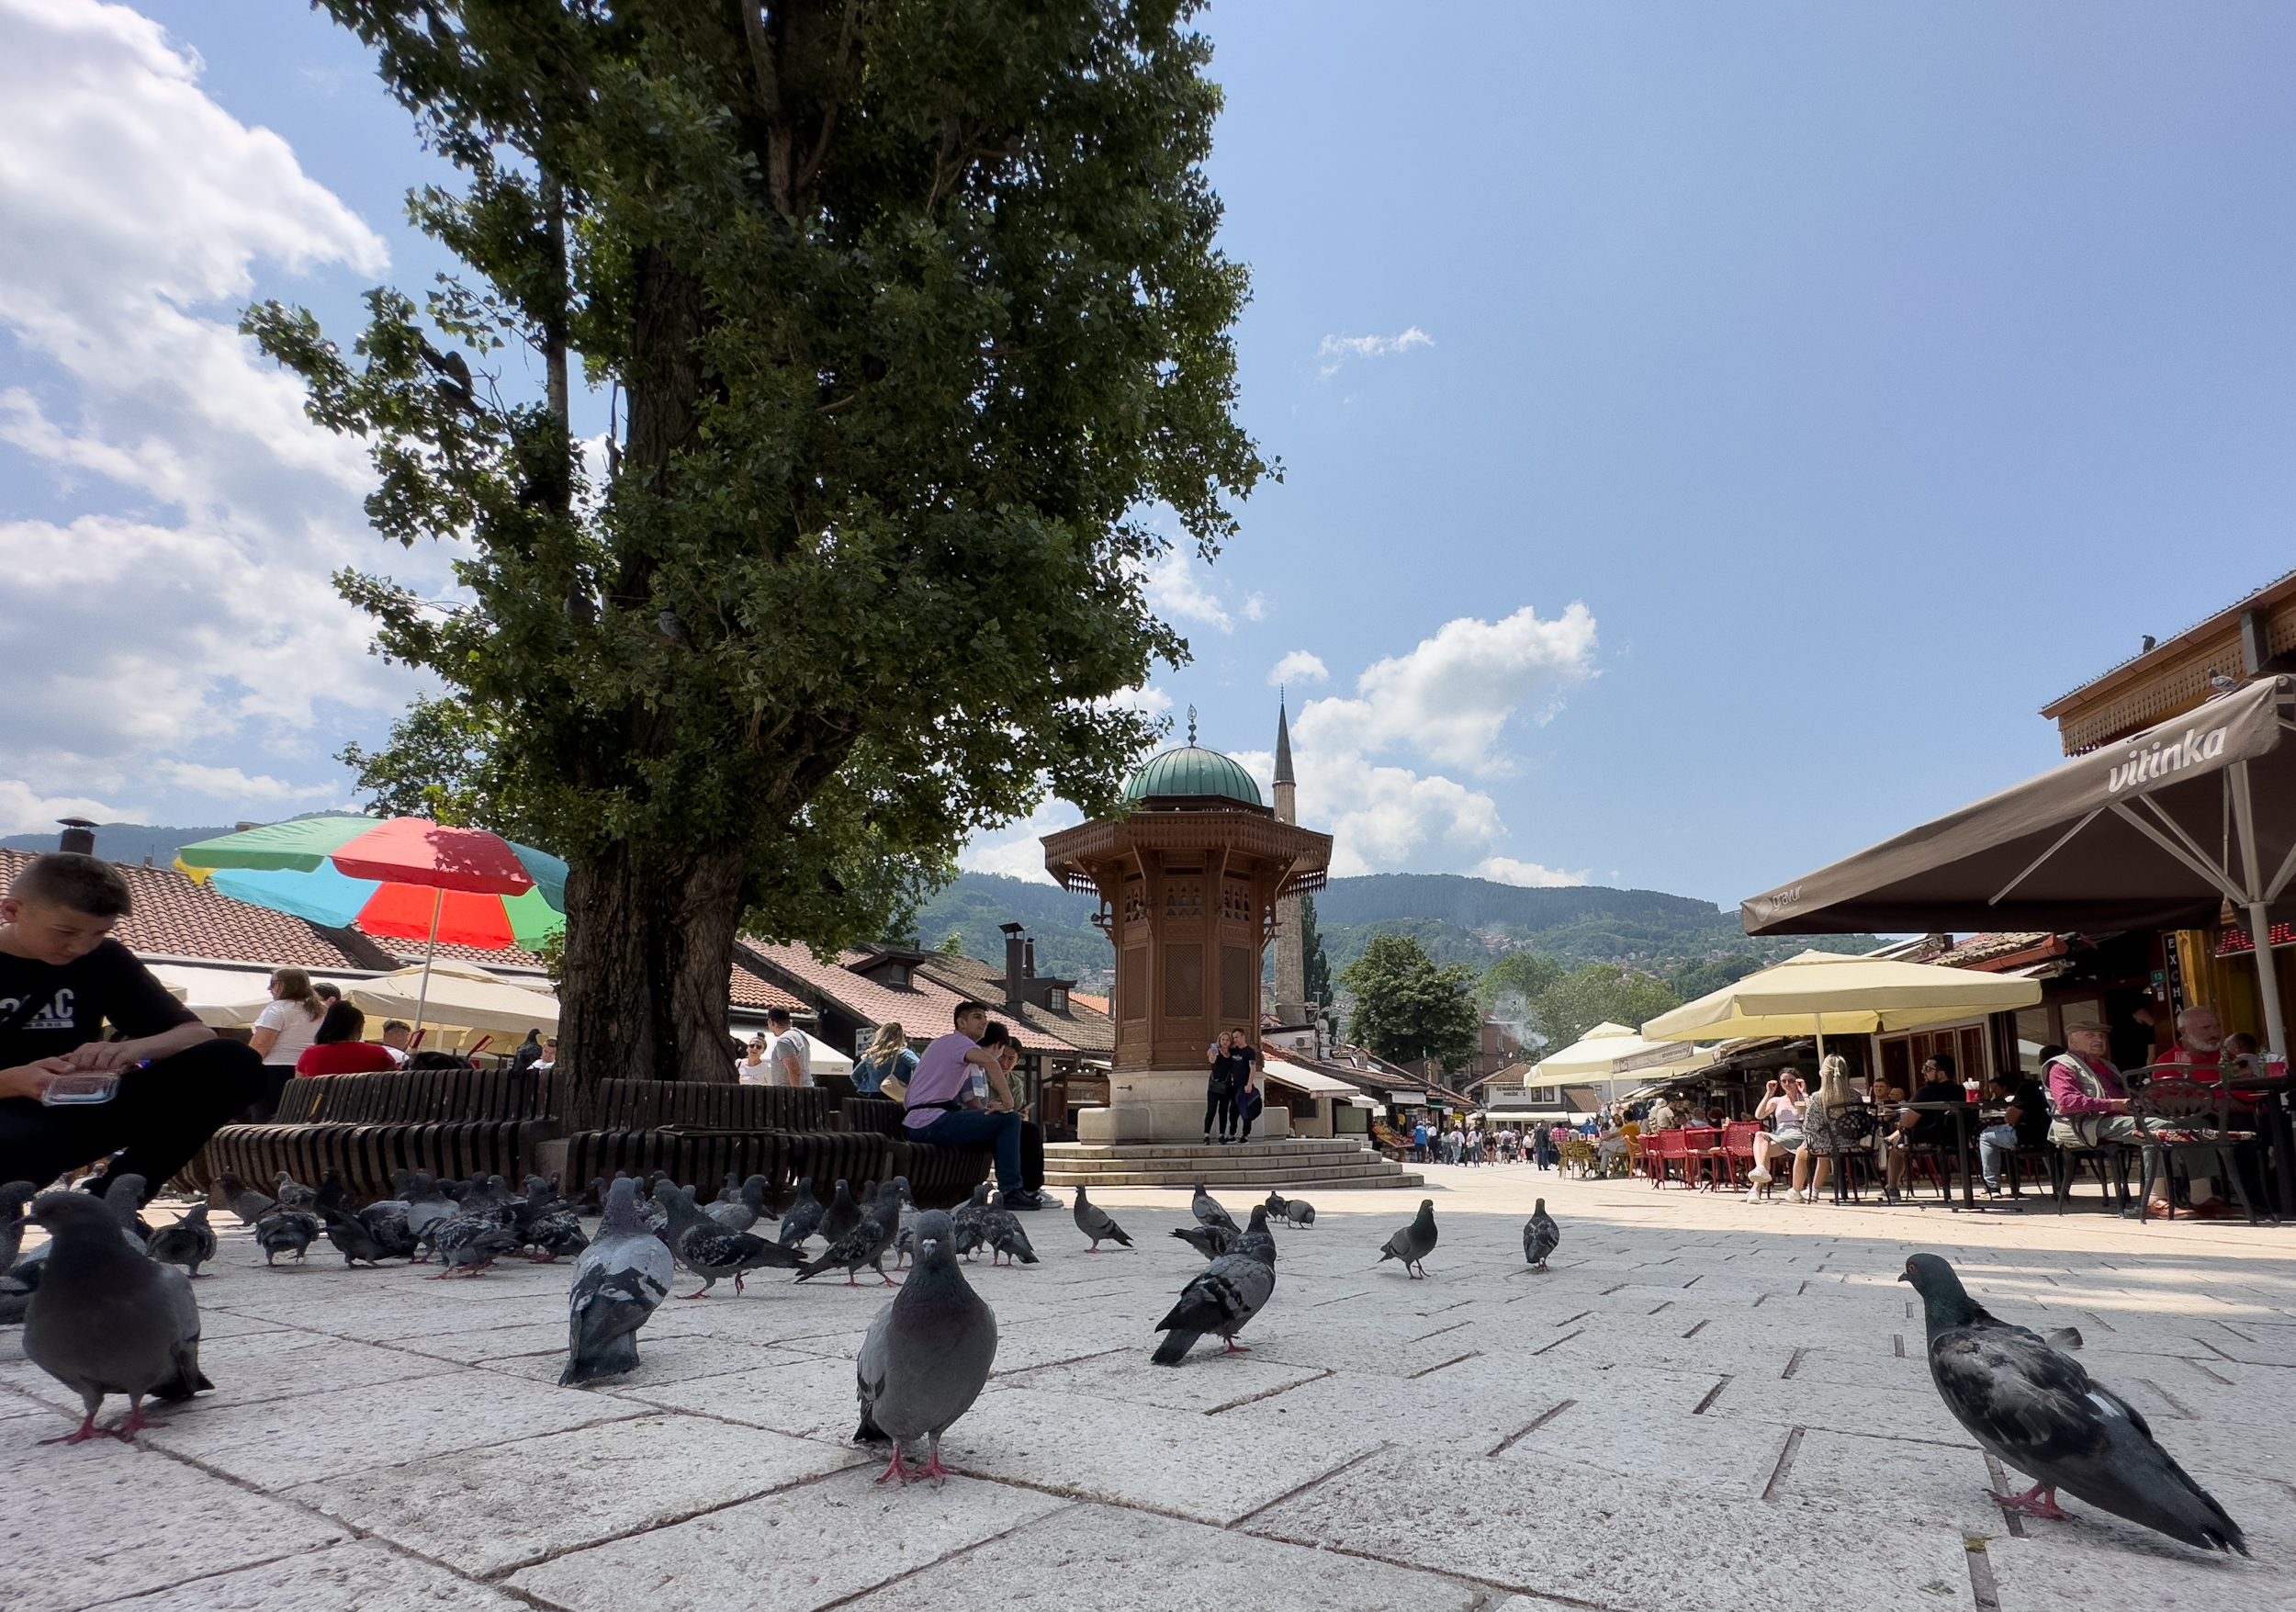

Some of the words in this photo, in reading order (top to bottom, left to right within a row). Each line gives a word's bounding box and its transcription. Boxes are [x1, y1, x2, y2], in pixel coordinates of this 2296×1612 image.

[2108, 727, 2228, 793] vitinka
[1773, 885, 1803, 912] gravur
[2153, 972, 2163, 981] 13
